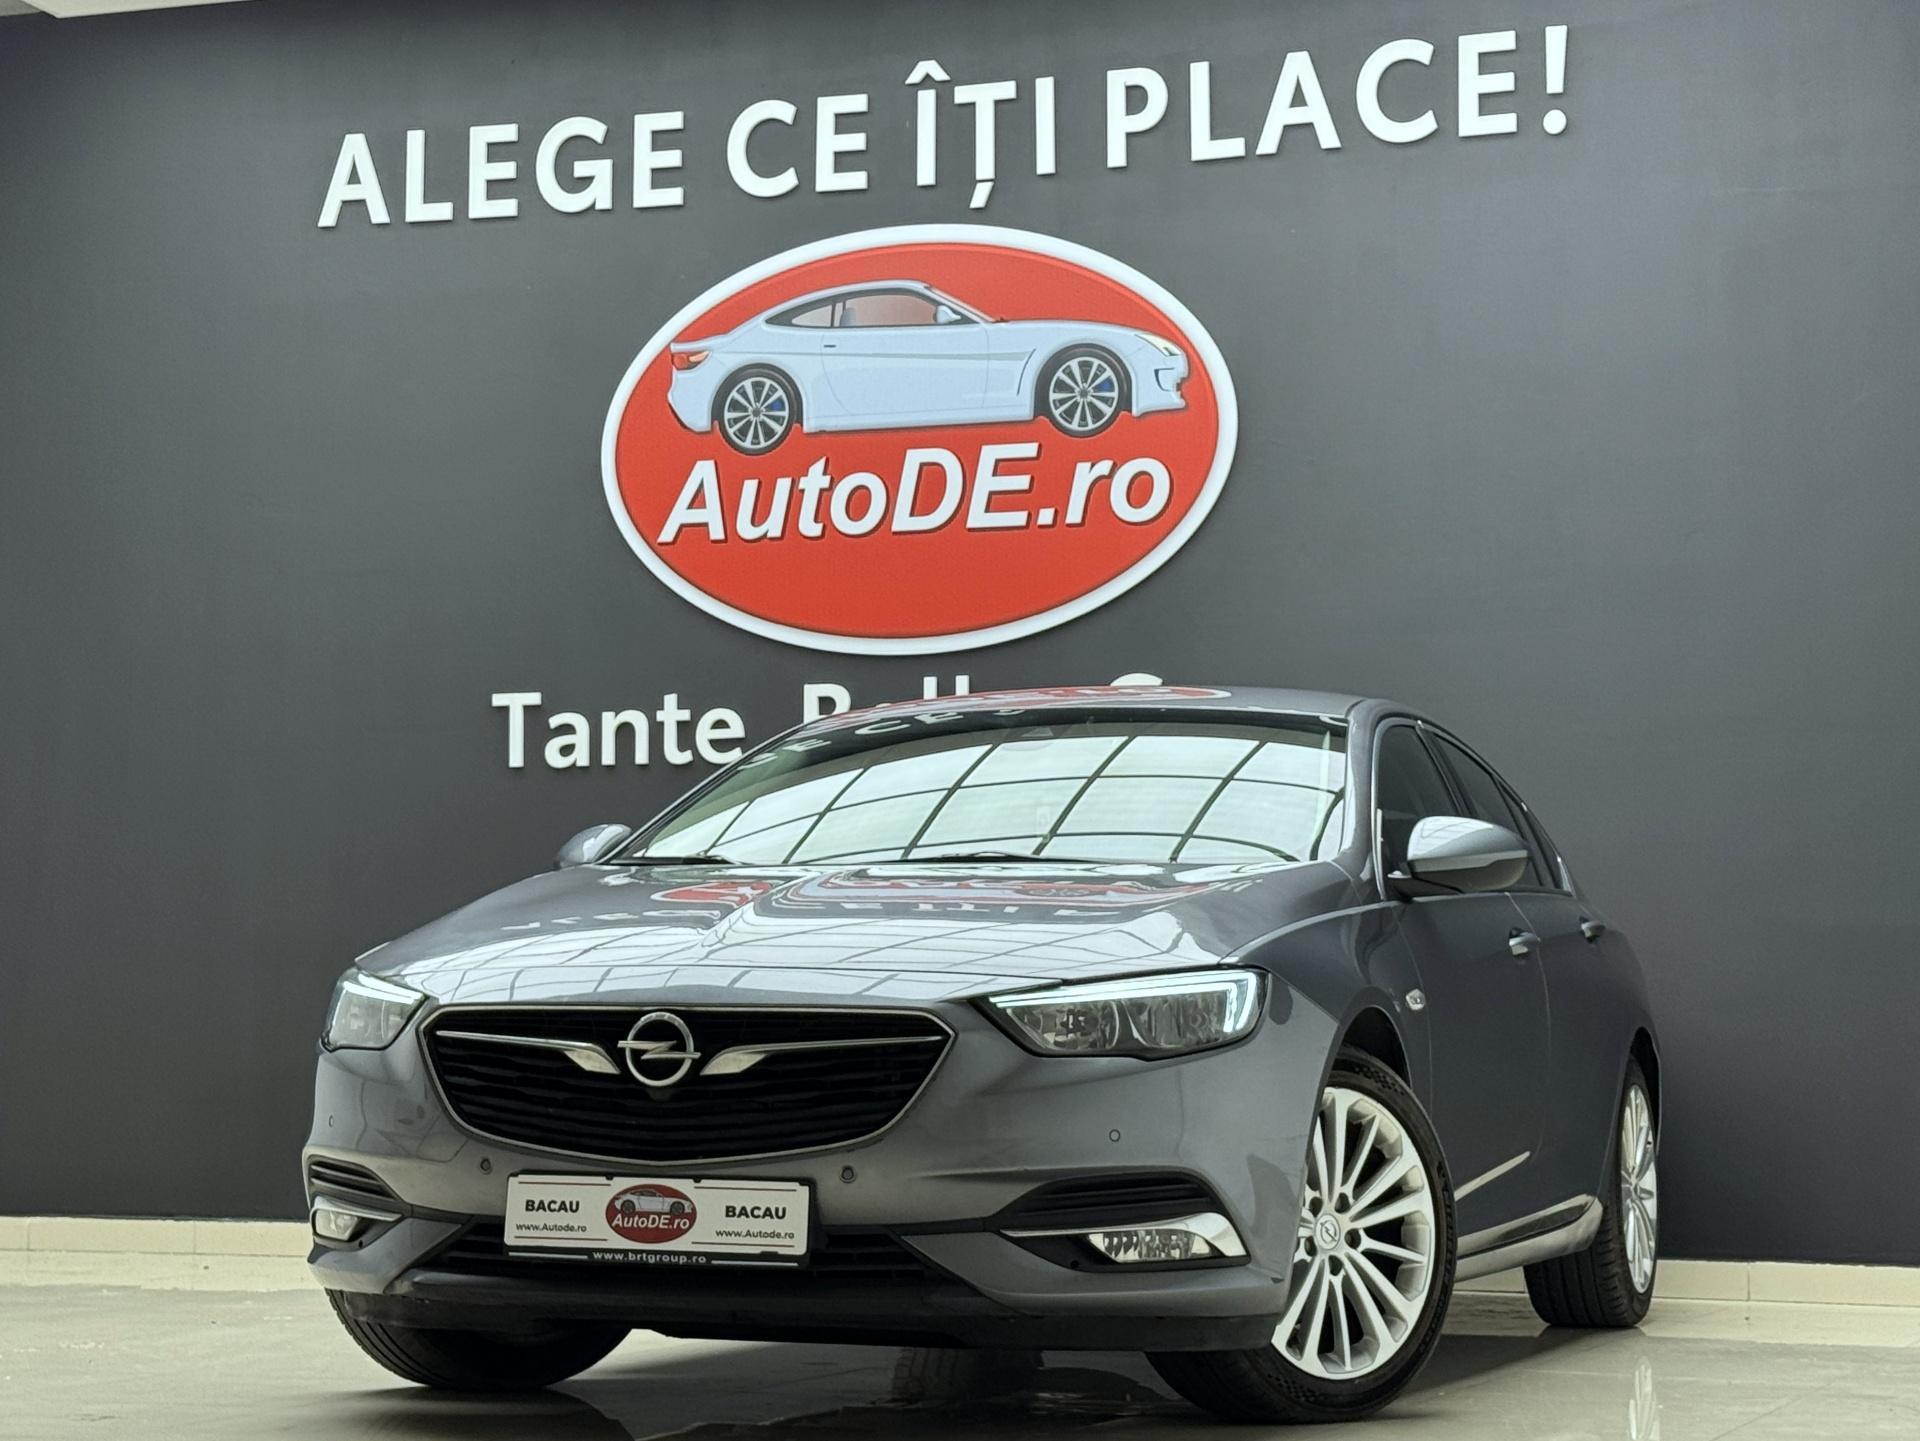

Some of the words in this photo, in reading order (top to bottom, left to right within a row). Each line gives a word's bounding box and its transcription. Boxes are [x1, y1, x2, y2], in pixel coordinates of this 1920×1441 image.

[317, 111, 684, 228] ALEGE
[726, 93, 869, 198] CE
[1106, 24, 1568, 169] PLACE!
[656, 441, 1172, 546] AutoDE.ro
[491, 691, 746, 769] Tante
[525, 1200, 580, 1213] BACAU
[725, 1205, 787, 1219] BACAU
[516, 1222, 587, 1232] www.Autode.ro
[611, 1213, 690, 1230] AutoDE.ro
[715, 1229, 795, 1239] www.Autode.ro
[592, 1251, 706, 1264] www.brtgroup.ro
